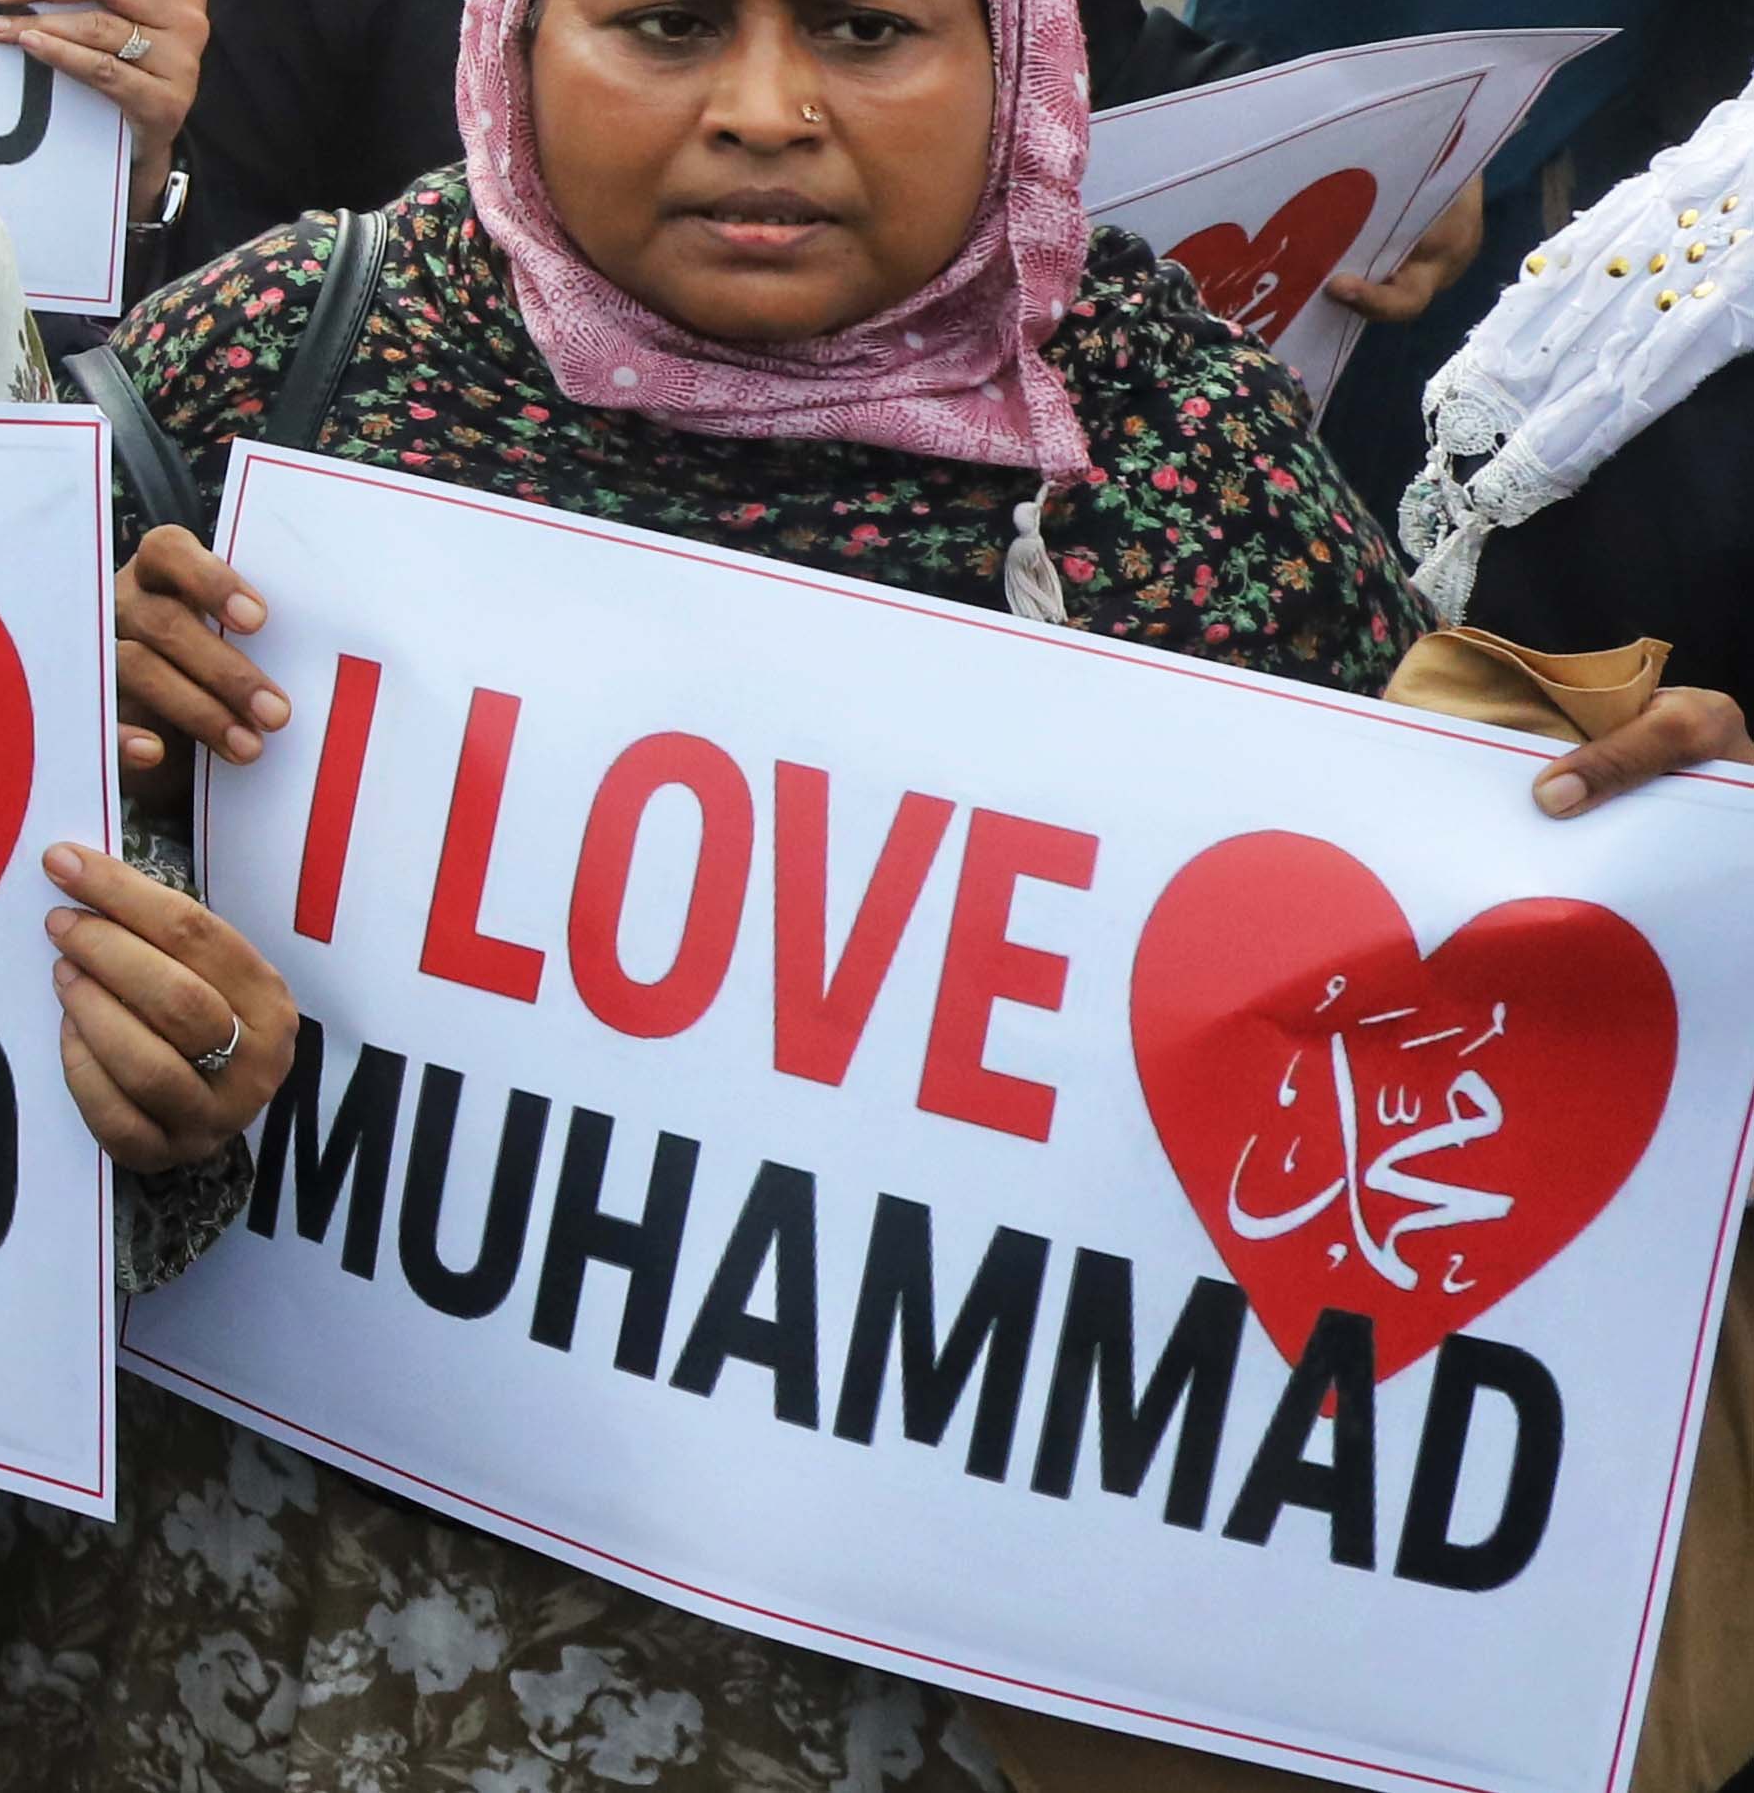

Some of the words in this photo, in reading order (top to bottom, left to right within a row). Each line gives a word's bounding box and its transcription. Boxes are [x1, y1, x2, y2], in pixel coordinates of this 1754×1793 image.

[295, 653, 381, 943] I
[418, 687, 1099, 1143] LOVE
[246, 1014, 1566, 1594] MUHAMMAD
